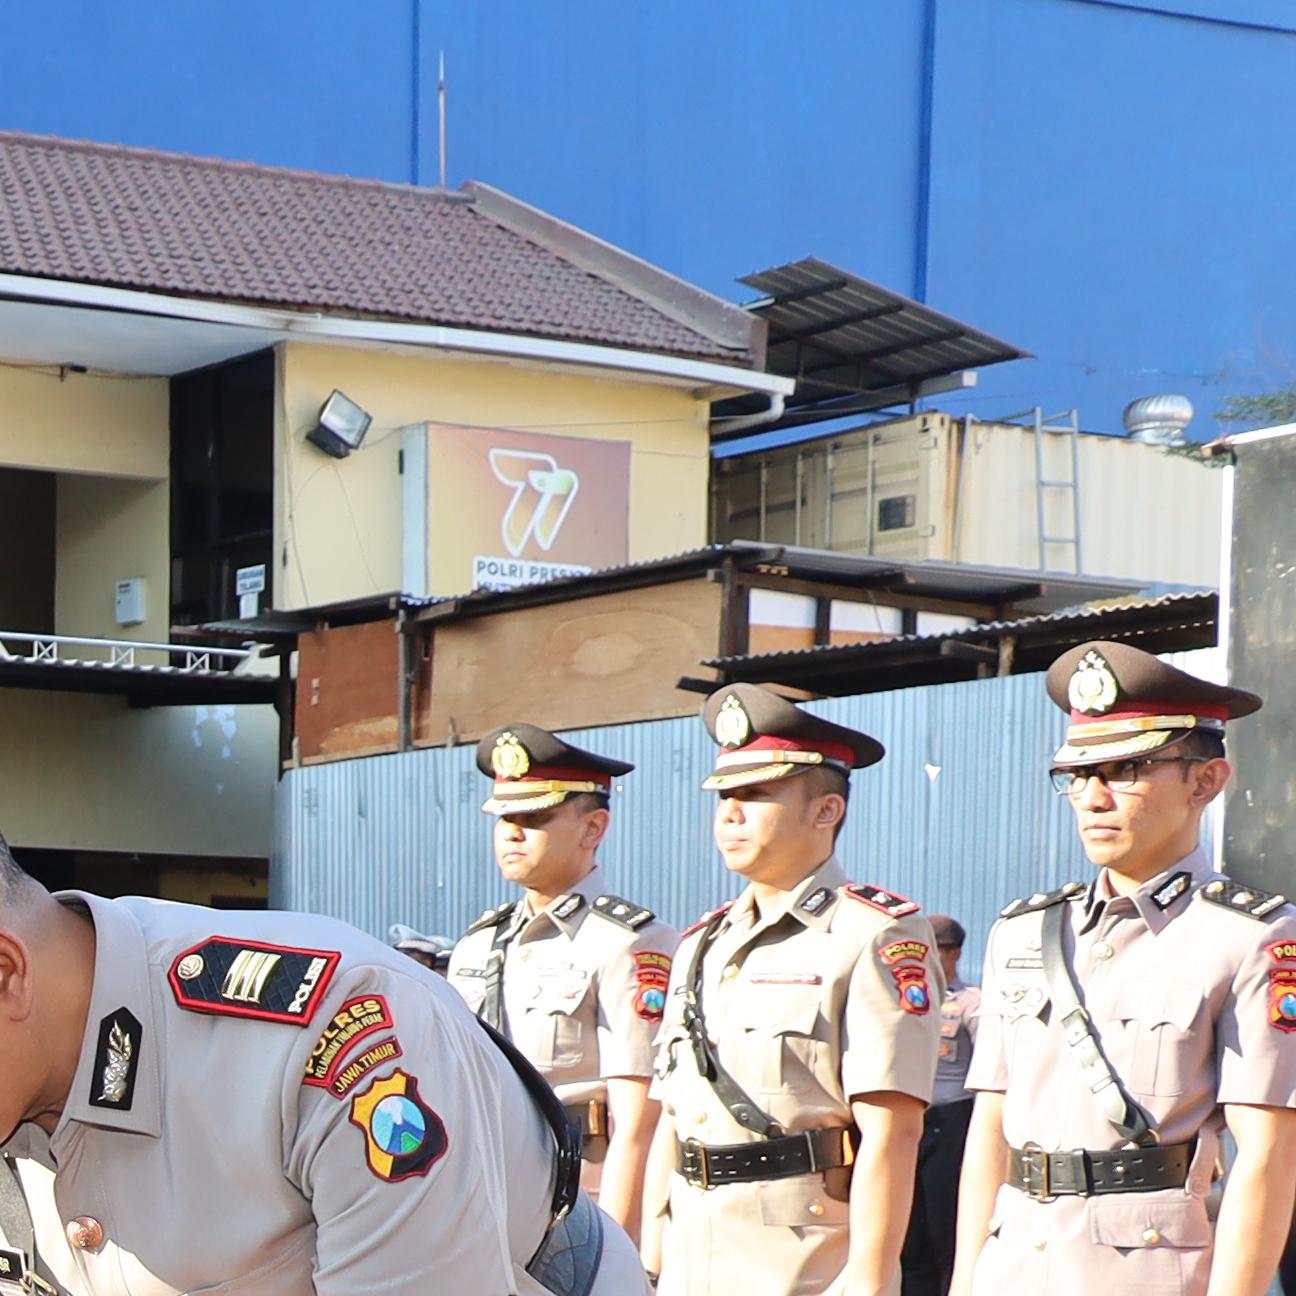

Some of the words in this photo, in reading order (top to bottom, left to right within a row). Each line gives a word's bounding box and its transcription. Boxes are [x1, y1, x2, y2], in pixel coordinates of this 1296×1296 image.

[477, 560, 523, 578] POLRI
[334, 1062, 365, 1093] JAWA
[358, 1043, 396, 1068] TIMUR
